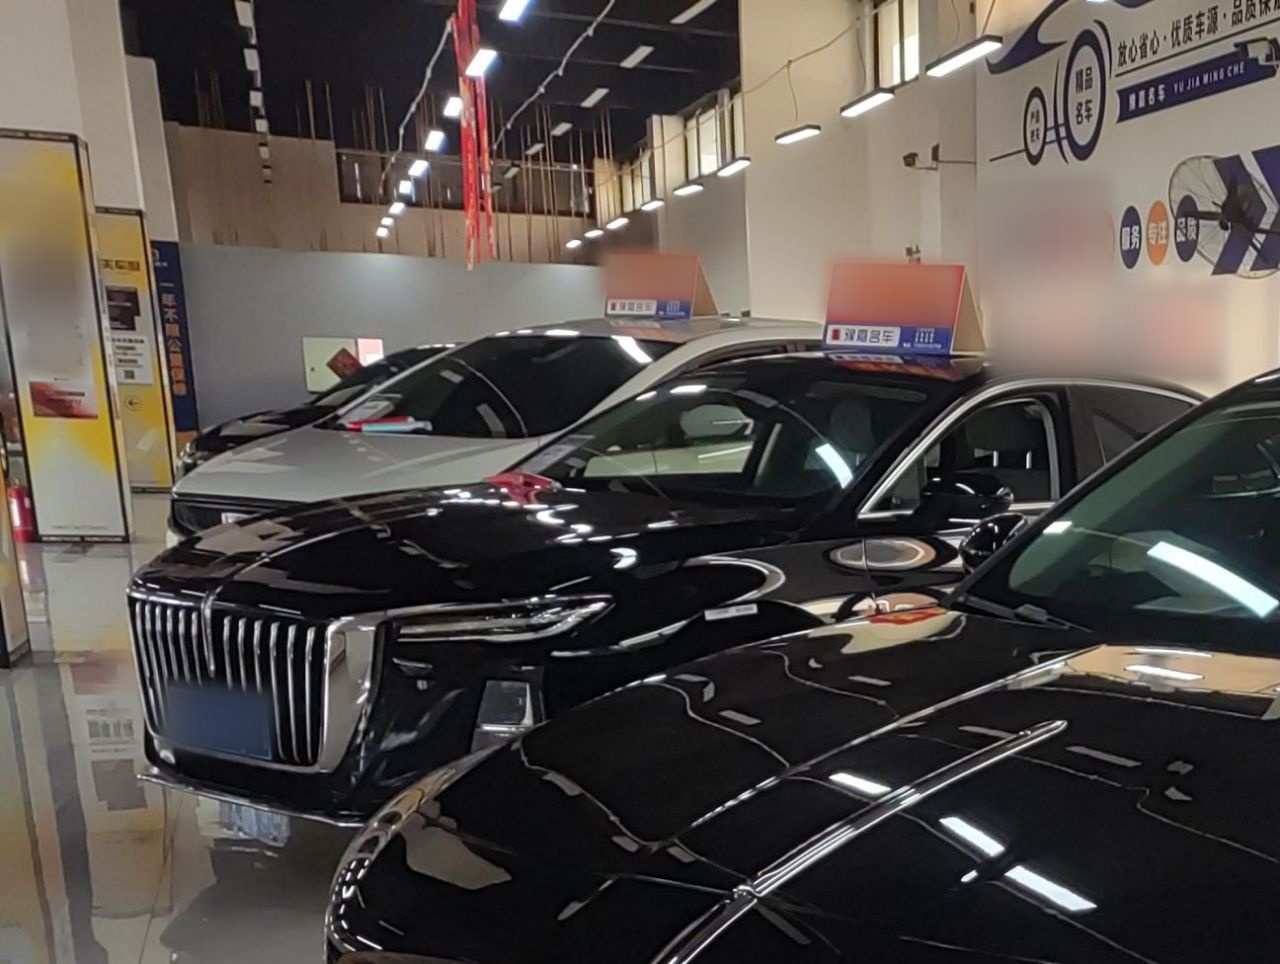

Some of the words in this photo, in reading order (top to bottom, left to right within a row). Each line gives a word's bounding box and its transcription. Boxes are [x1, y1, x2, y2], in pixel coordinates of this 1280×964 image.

[1076, 66, 1093, 94] 精品
[1173, 82, 1185, 95] YU
[1186, 76, 1201, 92] JIA
[1202, 67, 1225, 86] MING
[1228, 61, 1245, 78] CHE
[1076, 99, 1093, 125] 名车
[1122, 225, 1140, 250] 服务
[1148, 220, 1167, 245] 专注
[1176, 217, 1198, 242] 品质
